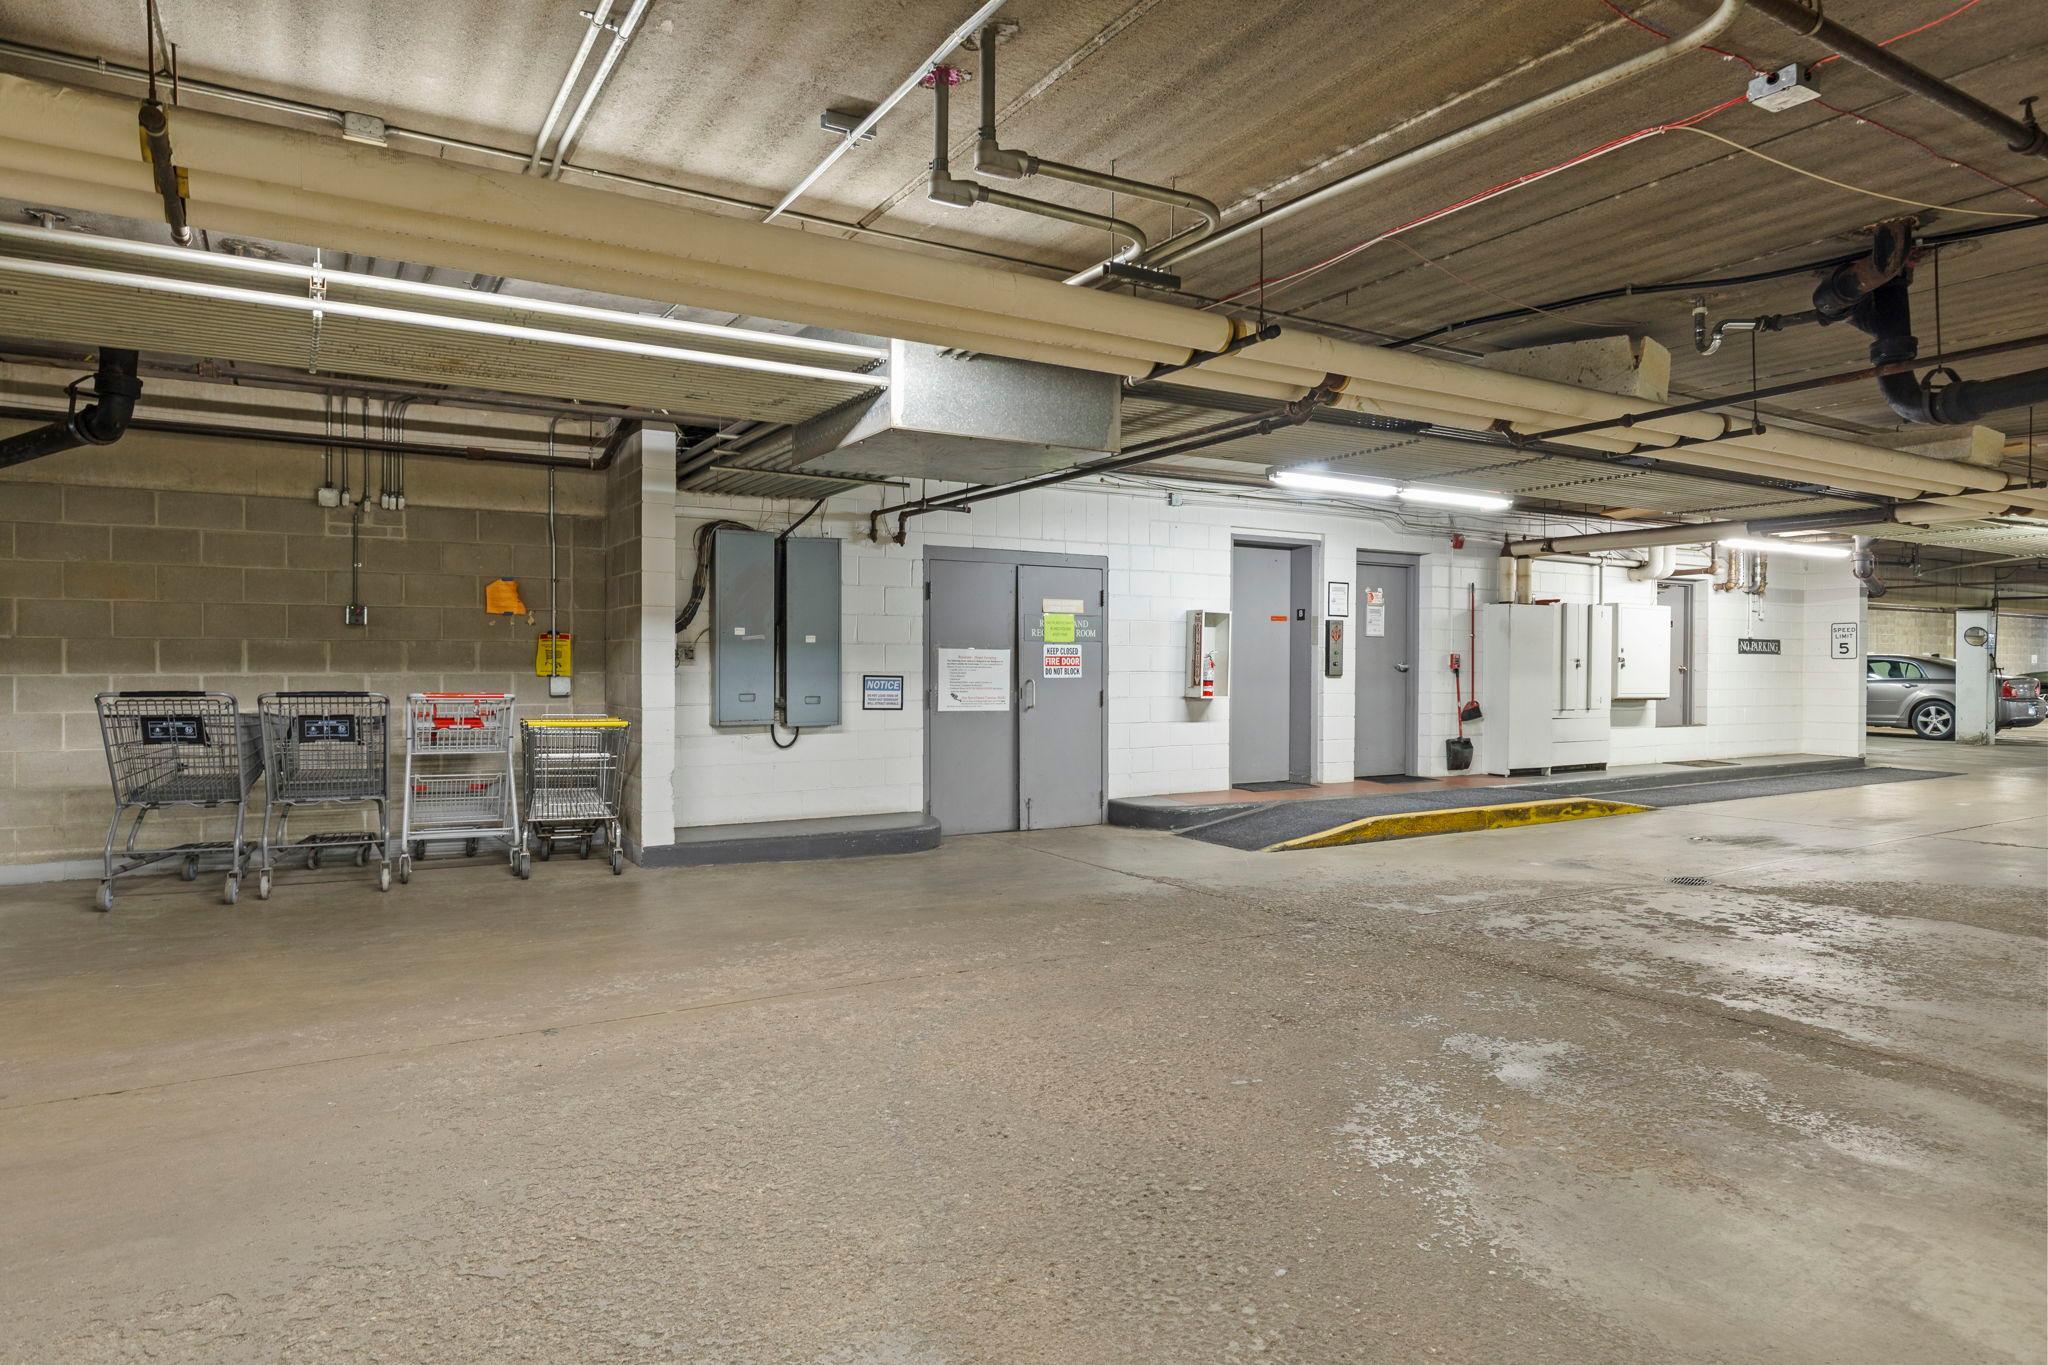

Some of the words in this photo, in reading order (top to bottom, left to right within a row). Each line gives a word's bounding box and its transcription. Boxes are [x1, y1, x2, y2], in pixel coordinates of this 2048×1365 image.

[1076, 629, 1096, 638] ROOM
[1739, 640, 1750, 651] NO
[1751, 641, 1778, 652] PARKING
[1839, 642, 1850, 655] 5
[1046, 647, 1059, 655] KEEP
[1060, 647, 1079, 655] CLOSED
[1045, 657, 1060, 666] FIRE
[1061, 657, 1080, 666] DOOR
[867, 681, 899, 689] NOTICE
